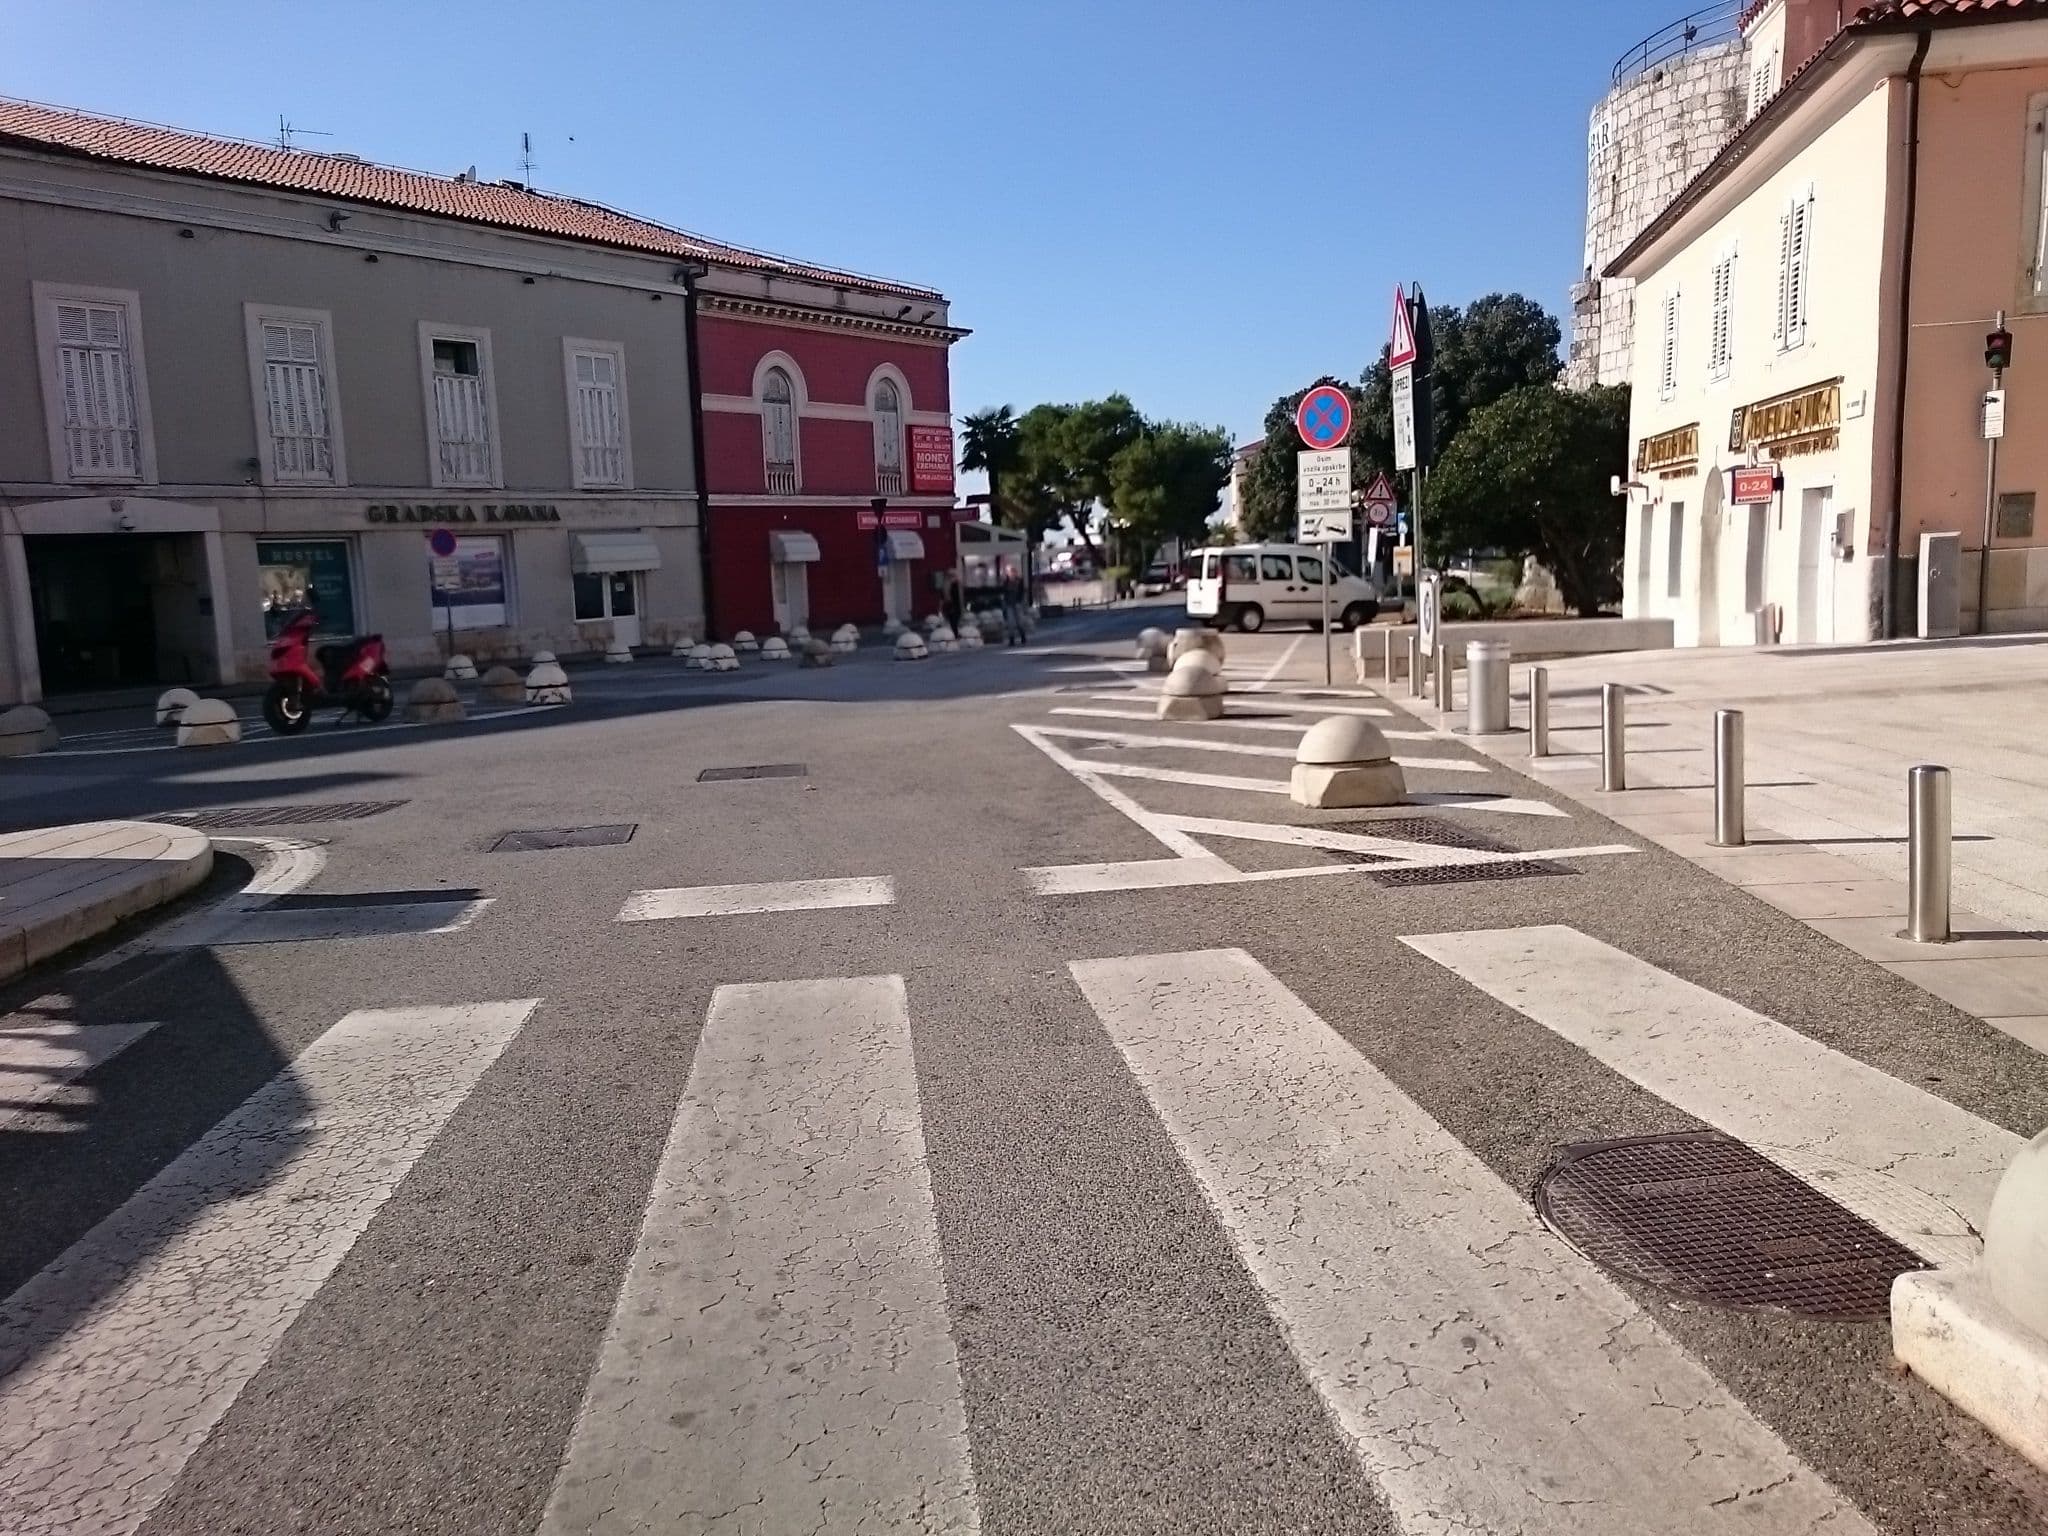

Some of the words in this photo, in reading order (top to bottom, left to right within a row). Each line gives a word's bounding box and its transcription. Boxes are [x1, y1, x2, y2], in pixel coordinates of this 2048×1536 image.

[916, 452, 949, 463] MONEY
[1322, 477, 1333, 487] 24
[1739, 480, 1769, 492] 0-24
[367, 505, 477, 522] GRADSKA
[271, 550, 335, 561] HOSTEL
